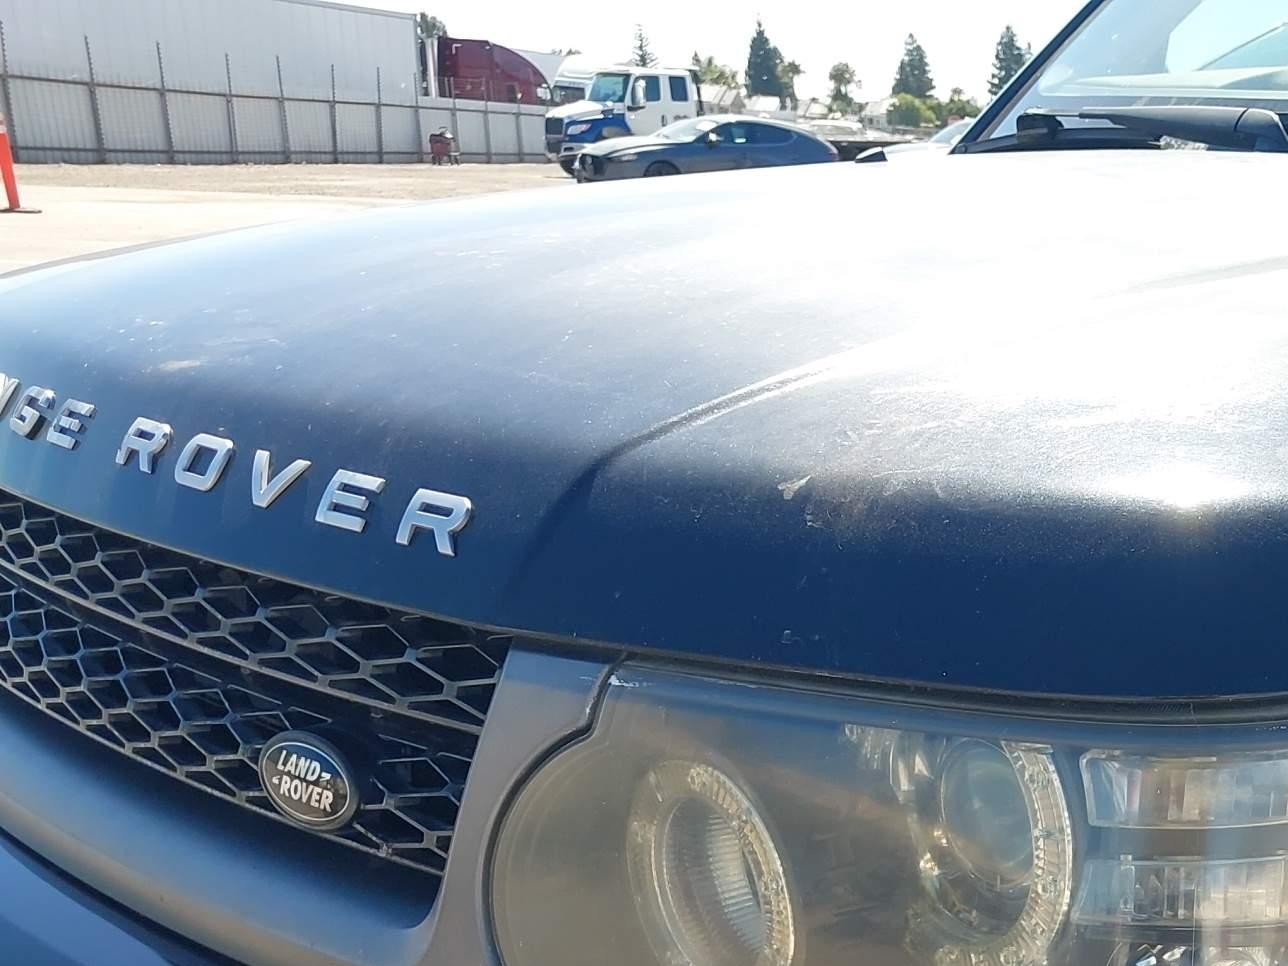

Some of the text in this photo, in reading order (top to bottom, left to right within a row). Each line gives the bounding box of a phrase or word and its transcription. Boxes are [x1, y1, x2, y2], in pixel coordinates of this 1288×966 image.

[115, 416, 472, 557] ROVER
[276, 749, 321, 782] LAND
[279, 774, 334, 813] ROVER
